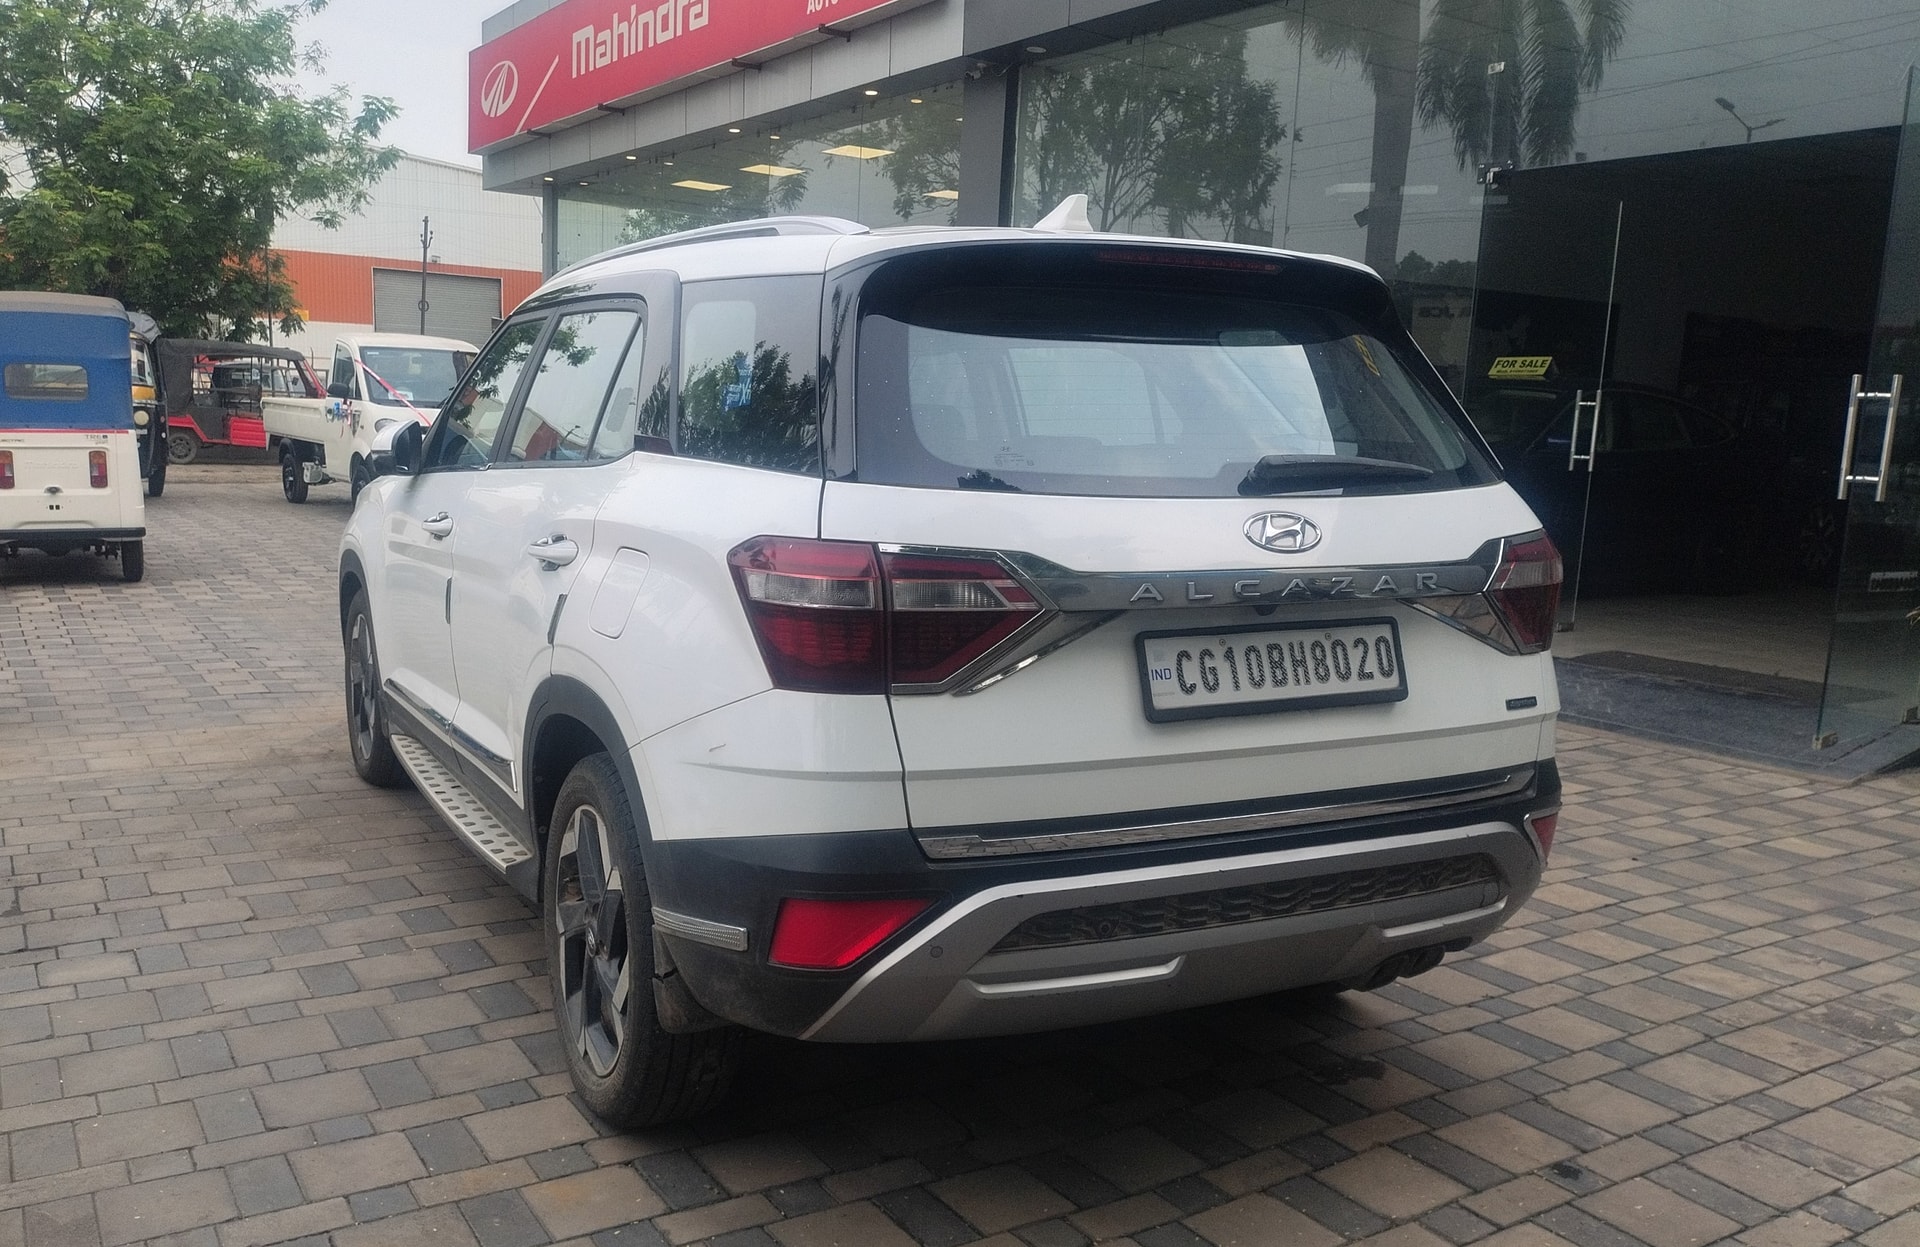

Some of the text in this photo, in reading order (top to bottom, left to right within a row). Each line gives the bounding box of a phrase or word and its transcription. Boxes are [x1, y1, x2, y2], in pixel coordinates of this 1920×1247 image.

[806, 0, 838, 15] AU
[572, 0, 709, 79] Mahindra
[1494, 359, 1548, 368] FOR SALE
[1130, 572, 1438, 602] ALCAZAR
[1151, 668, 1172, 680] IND
[1176, 635, 1395, 696] CG10BH8020
